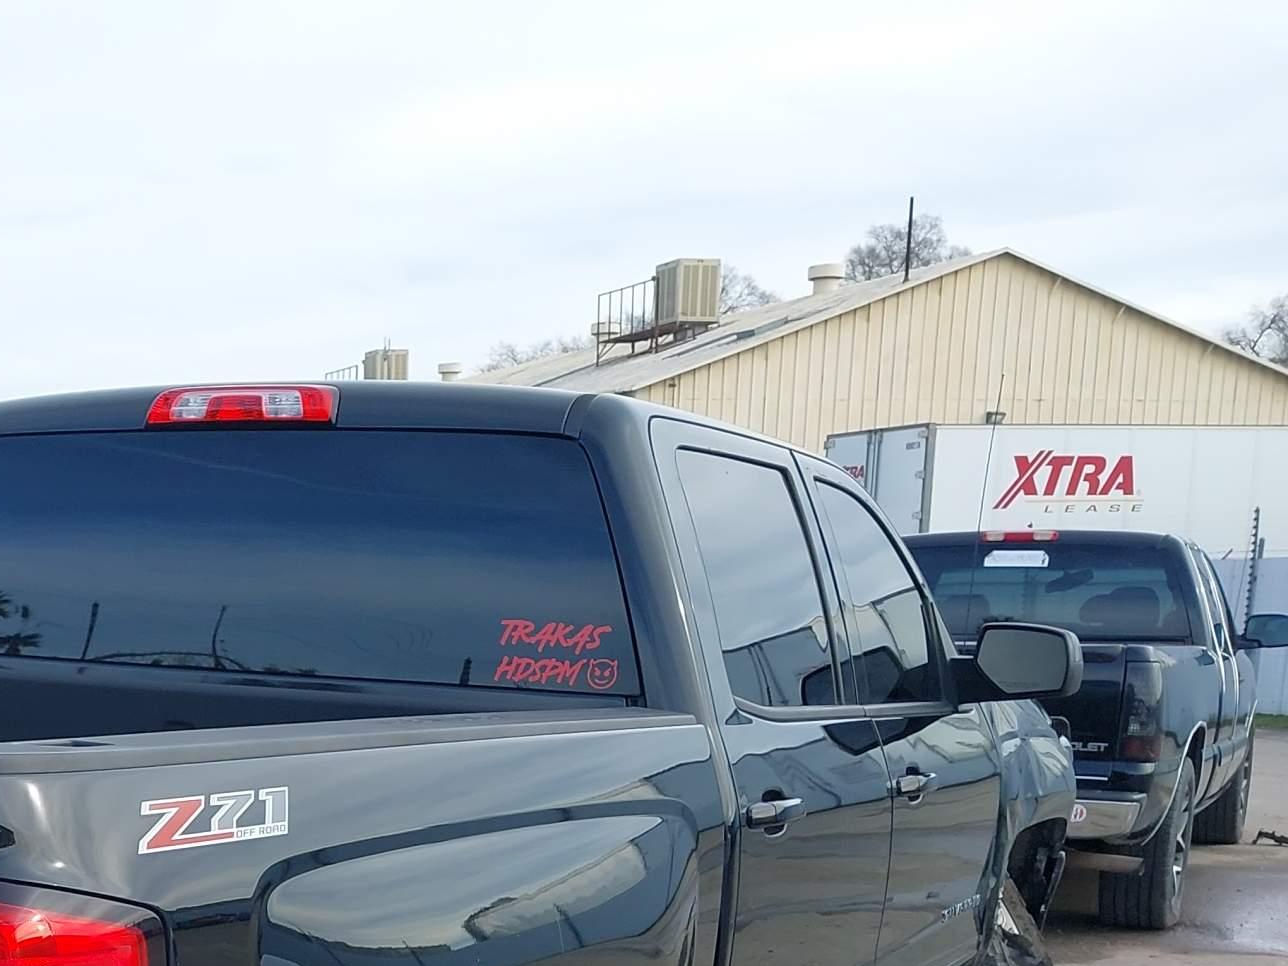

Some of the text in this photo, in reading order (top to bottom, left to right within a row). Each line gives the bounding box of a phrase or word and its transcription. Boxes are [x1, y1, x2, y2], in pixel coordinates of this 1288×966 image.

[993, 450, 1134, 509] XTRA
[1043, 504, 1143, 513] LEASE
[500, 619, 612, 656] TRAKAS
[494, 655, 587, 686] HDSPM
[138, 786, 289, 855] Z71
[236, 824, 286, 838] OFF ROAD
